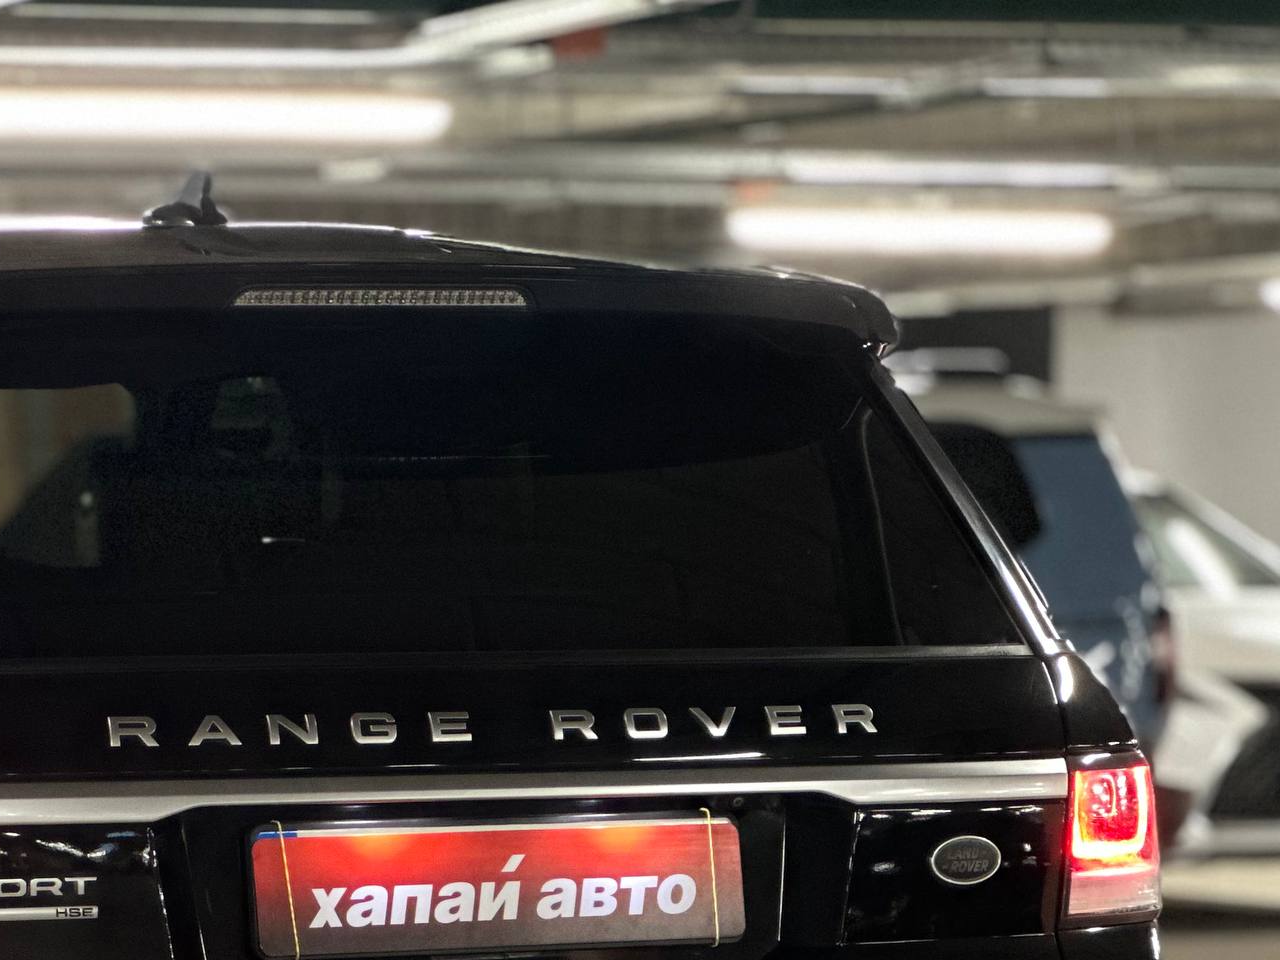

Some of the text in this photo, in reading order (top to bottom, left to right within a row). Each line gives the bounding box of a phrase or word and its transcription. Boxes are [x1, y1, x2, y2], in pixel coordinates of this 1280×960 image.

[106, 703, 878, 748] RANGE ROVER
[949, 860, 989, 873] ROVER
[536, 873, 697, 920] авто
[55, 907, 95, 919] HSE
